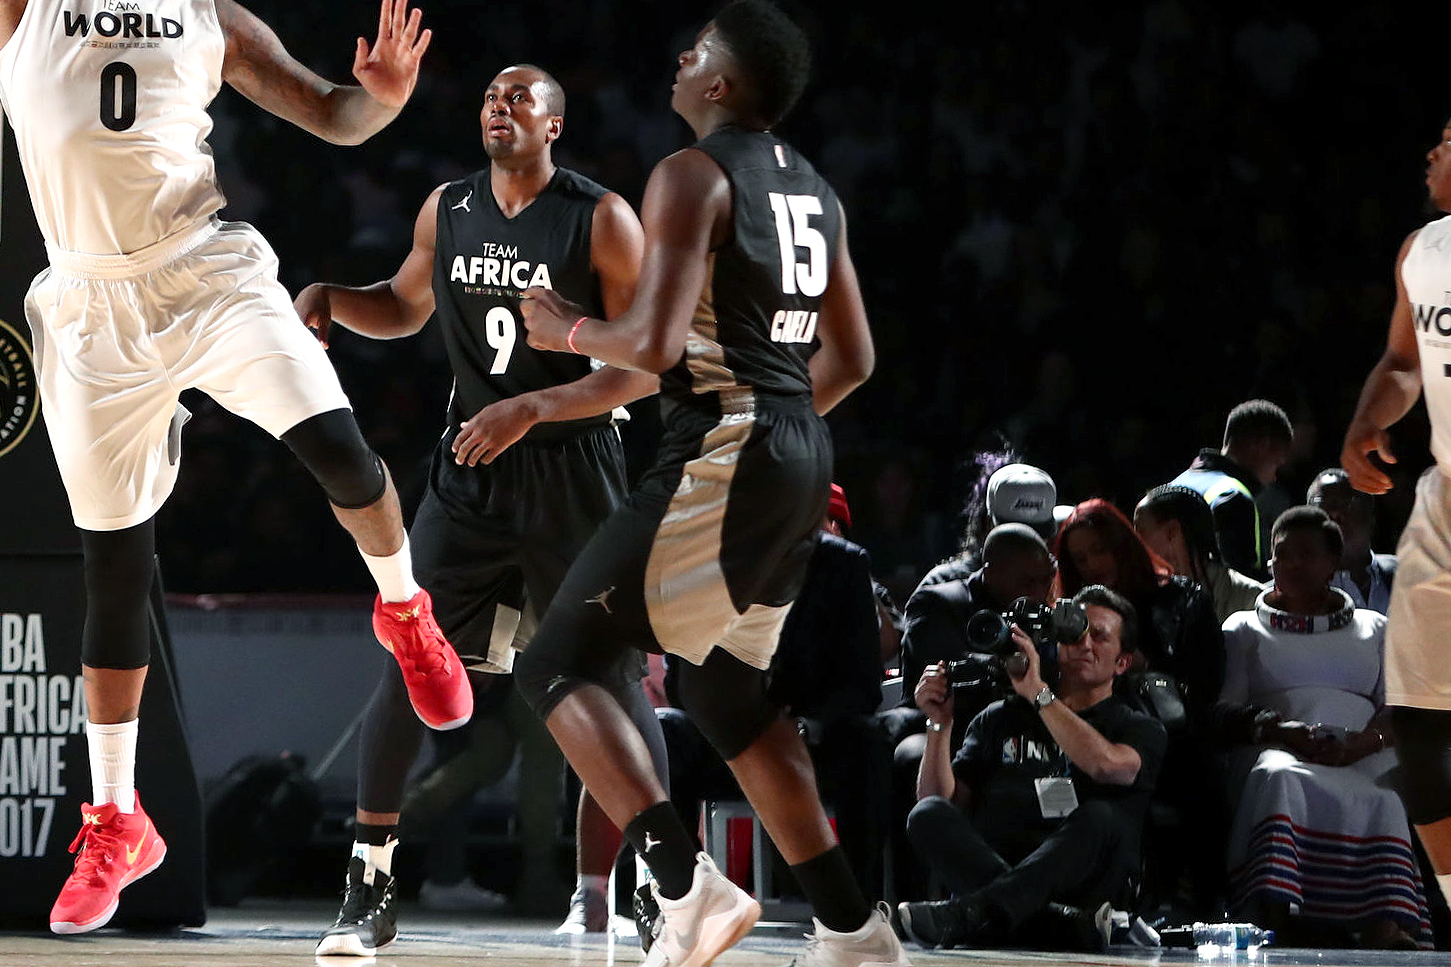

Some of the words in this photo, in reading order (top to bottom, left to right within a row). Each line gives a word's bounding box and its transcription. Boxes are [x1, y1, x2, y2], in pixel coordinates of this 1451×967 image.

[63, 11, 184, 39] WORLD
[100, 61, 137, 132] 0
[482, 242, 518, 260] TEAM
[768, 191, 828, 298] 15
[451, 255, 553, 291] AFRICA
[485, 306, 517, 375] 9
